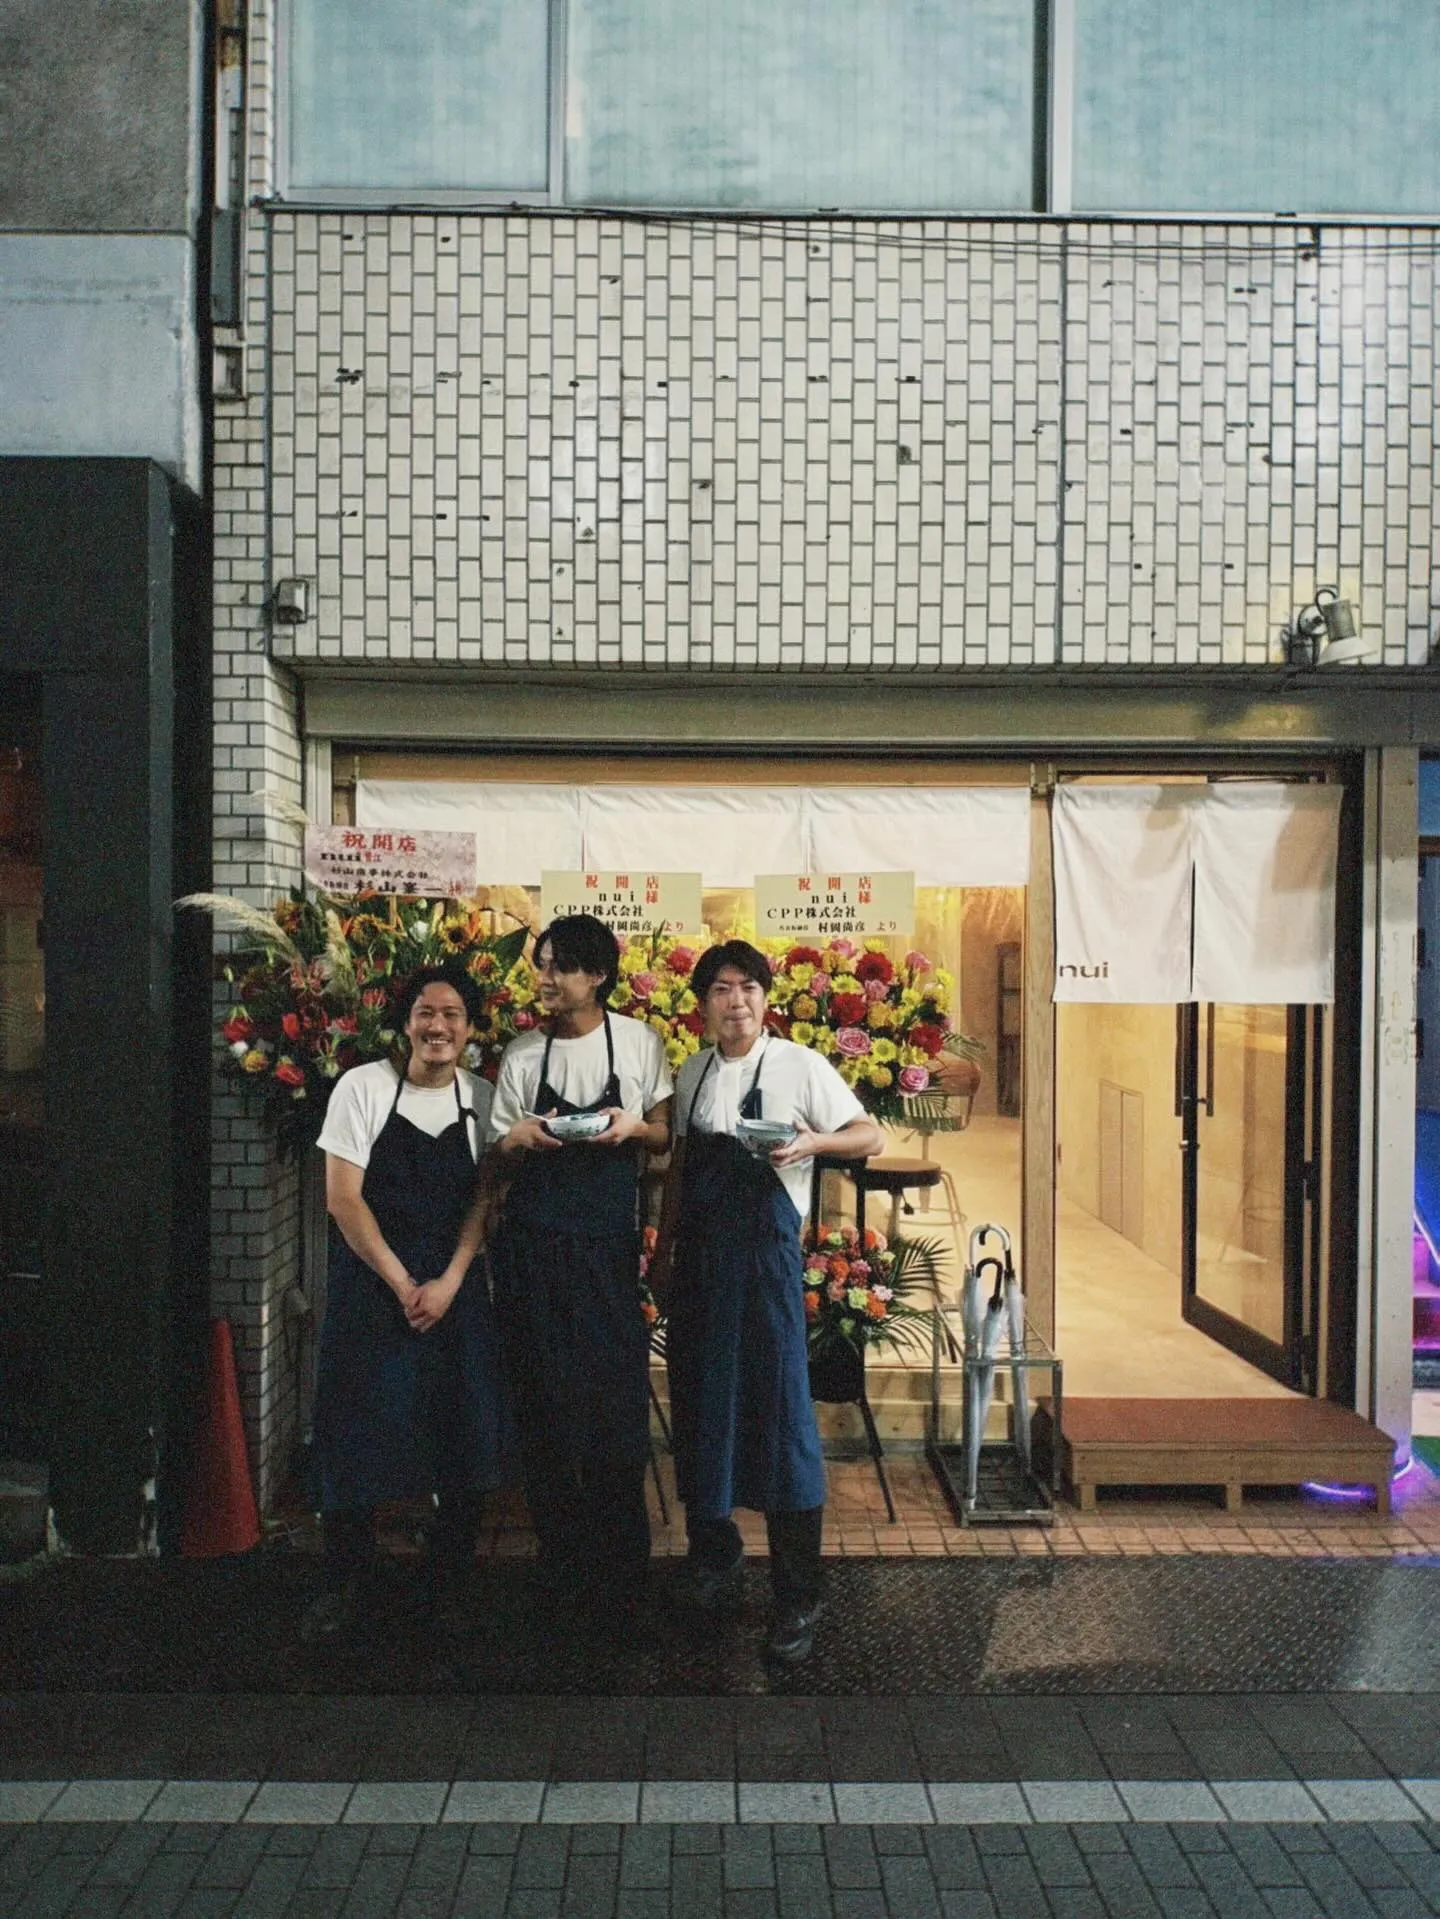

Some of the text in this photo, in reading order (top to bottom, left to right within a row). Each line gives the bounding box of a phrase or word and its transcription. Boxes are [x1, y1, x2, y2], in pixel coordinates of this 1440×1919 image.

[343, 831, 417, 852] 祝開店
[586, 874, 659, 889] 祝開店
[798, 876, 872, 891] 祝開店
[599, 890, 659, 903] nui 様
[811, 891, 872, 904] nui 様
[553, 904, 645, 918] CPP株式会社
[767, 906, 857, 919] CPP株式会社
[664, 921, 685, 932] より
[876, 921, 898, 932] より
[1059, 961, 1109, 978] nui
